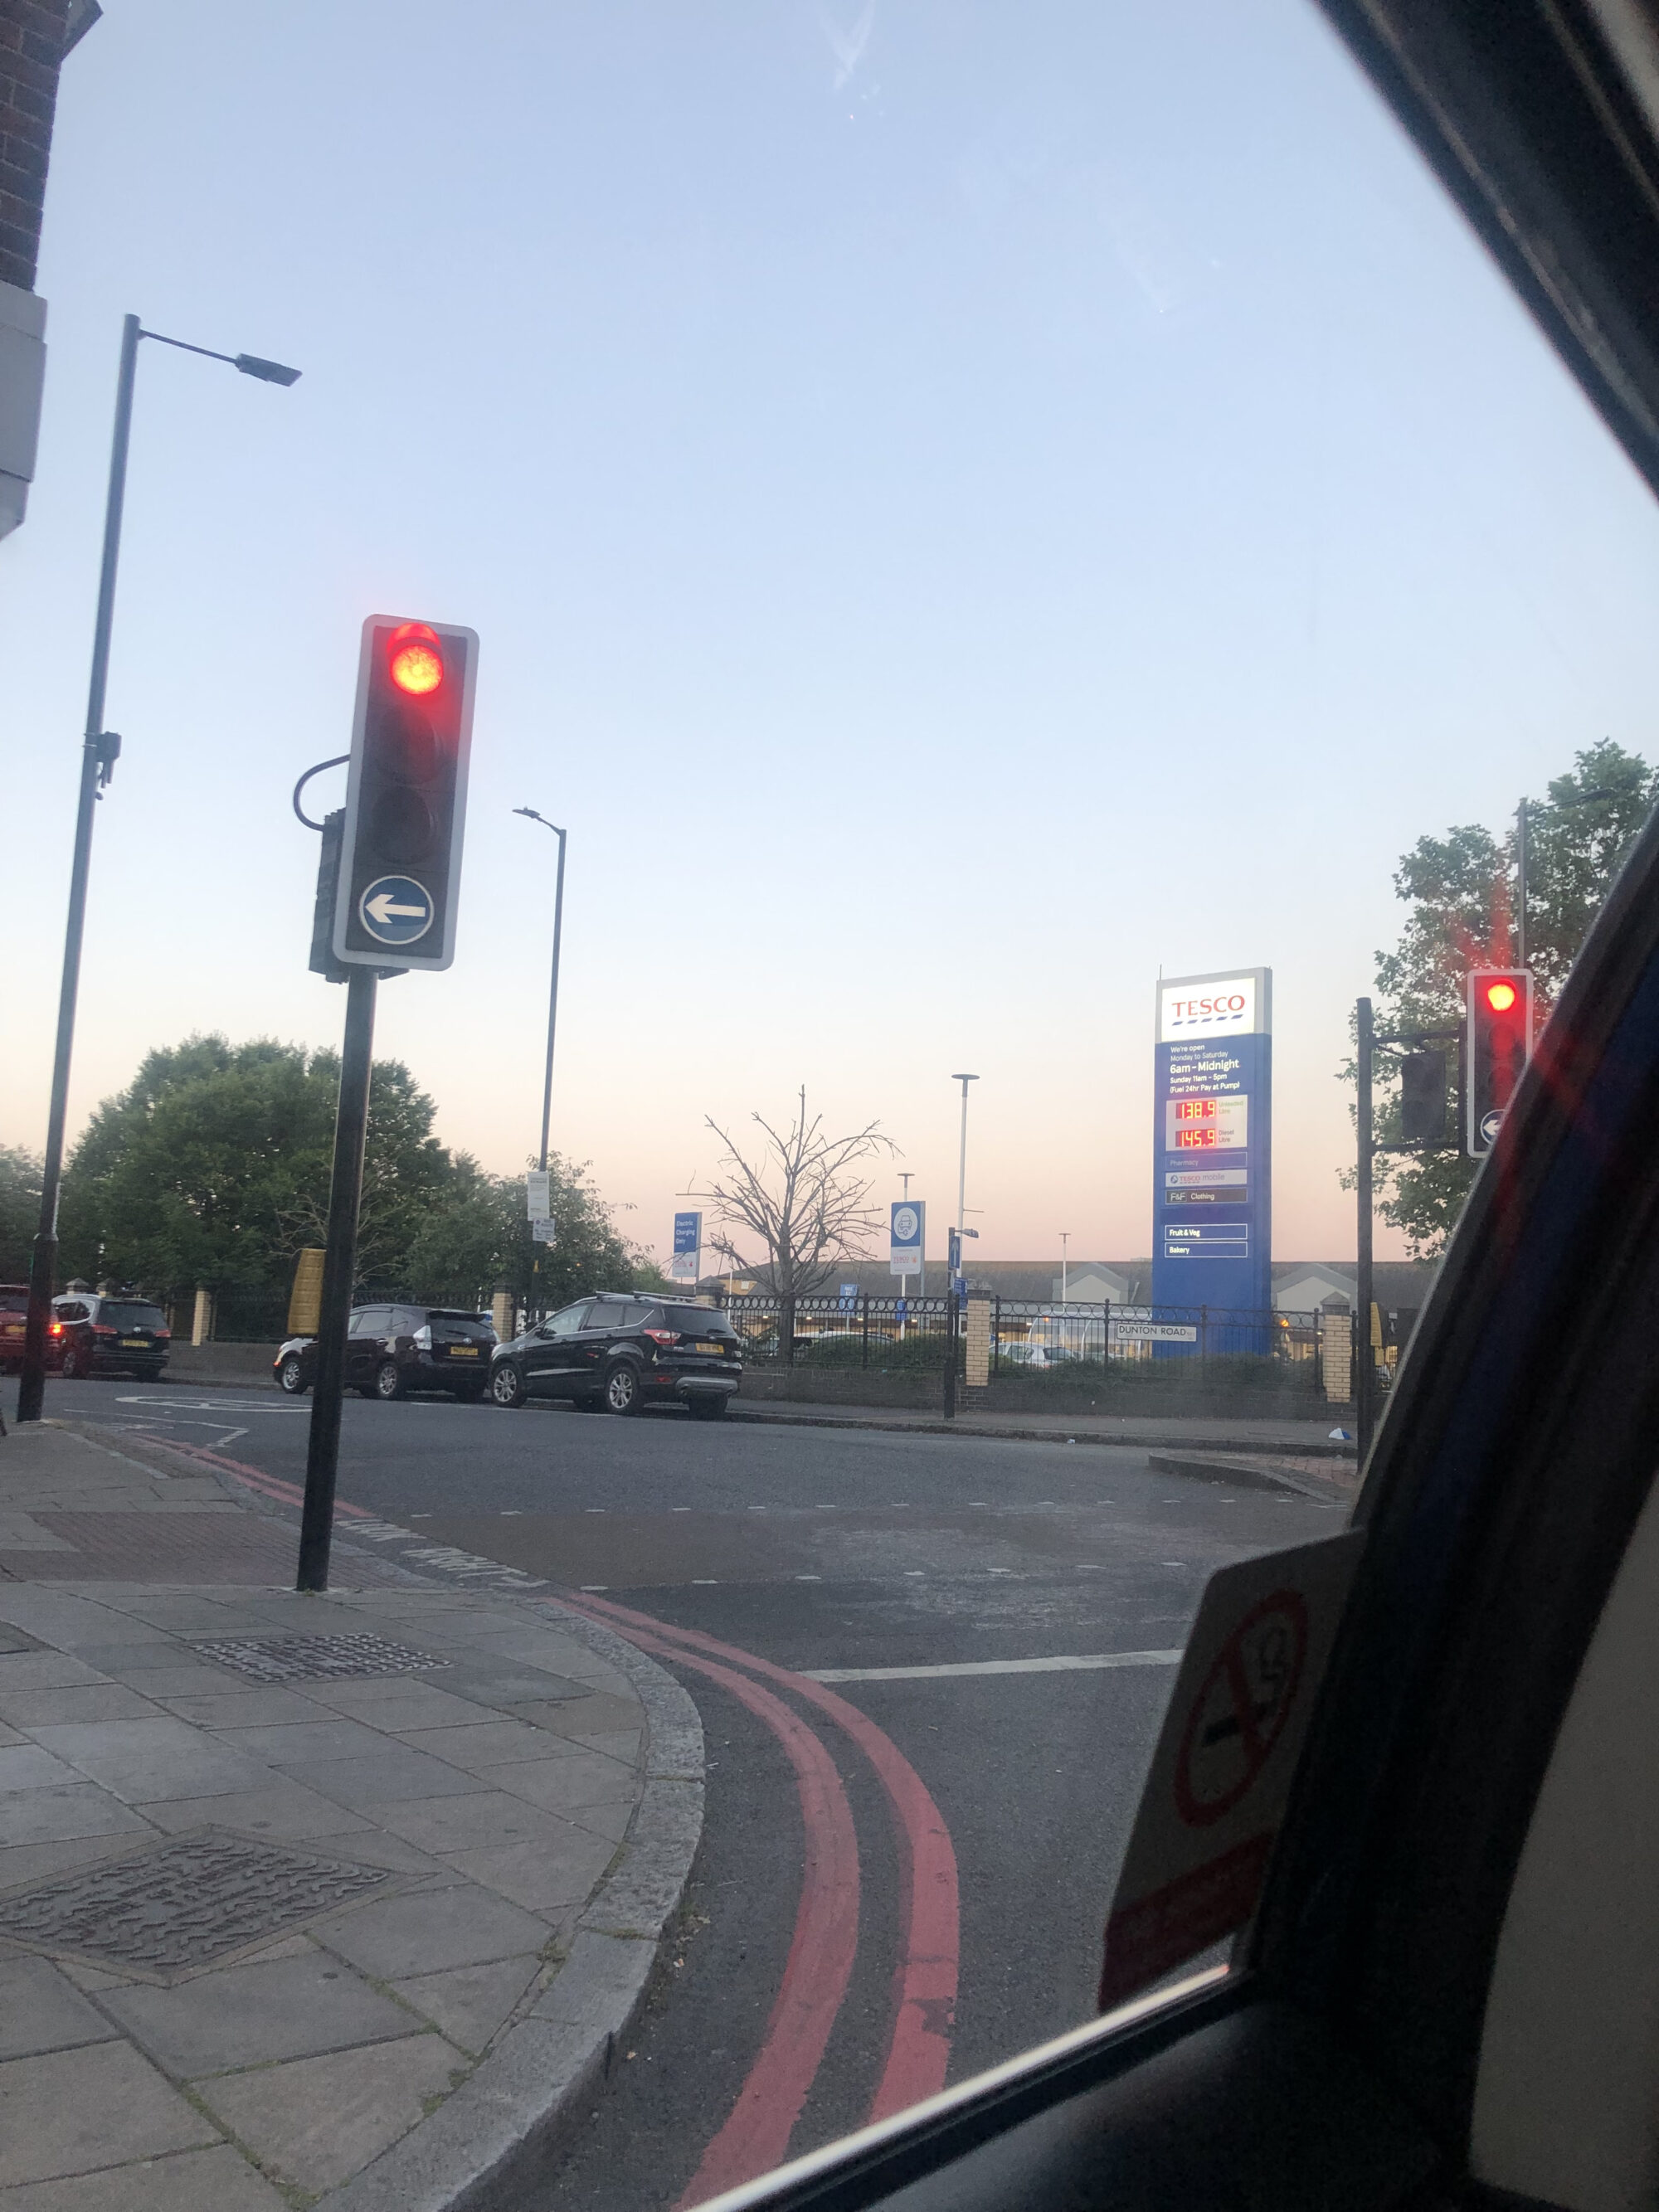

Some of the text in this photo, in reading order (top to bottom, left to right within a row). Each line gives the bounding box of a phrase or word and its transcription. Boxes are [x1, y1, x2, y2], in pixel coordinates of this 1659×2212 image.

[1171, 994, 1246, 1018] TESCO
[1170, 1053, 1193, 1062] Monday
[1170, 1064, 1190, 1074] 6am
[1198, 1059, 1240, 1072] Midnight
[1170, 1076, 1191, 1084] Sunday
[1181, 1101, 1215, 1119] 138.9
[1181, 1130, 1215, 1147] 145.9
[1170, 1193, 1215, 1201] F&F Clothing
[1189, 1228, 1200, 1237] Veg
[1170, 1246, 1190, 1255] Bakery
[1119, 1325, 1157, 1334] DUNTON
[1160, 1327, 1186, 1336] ROAD
